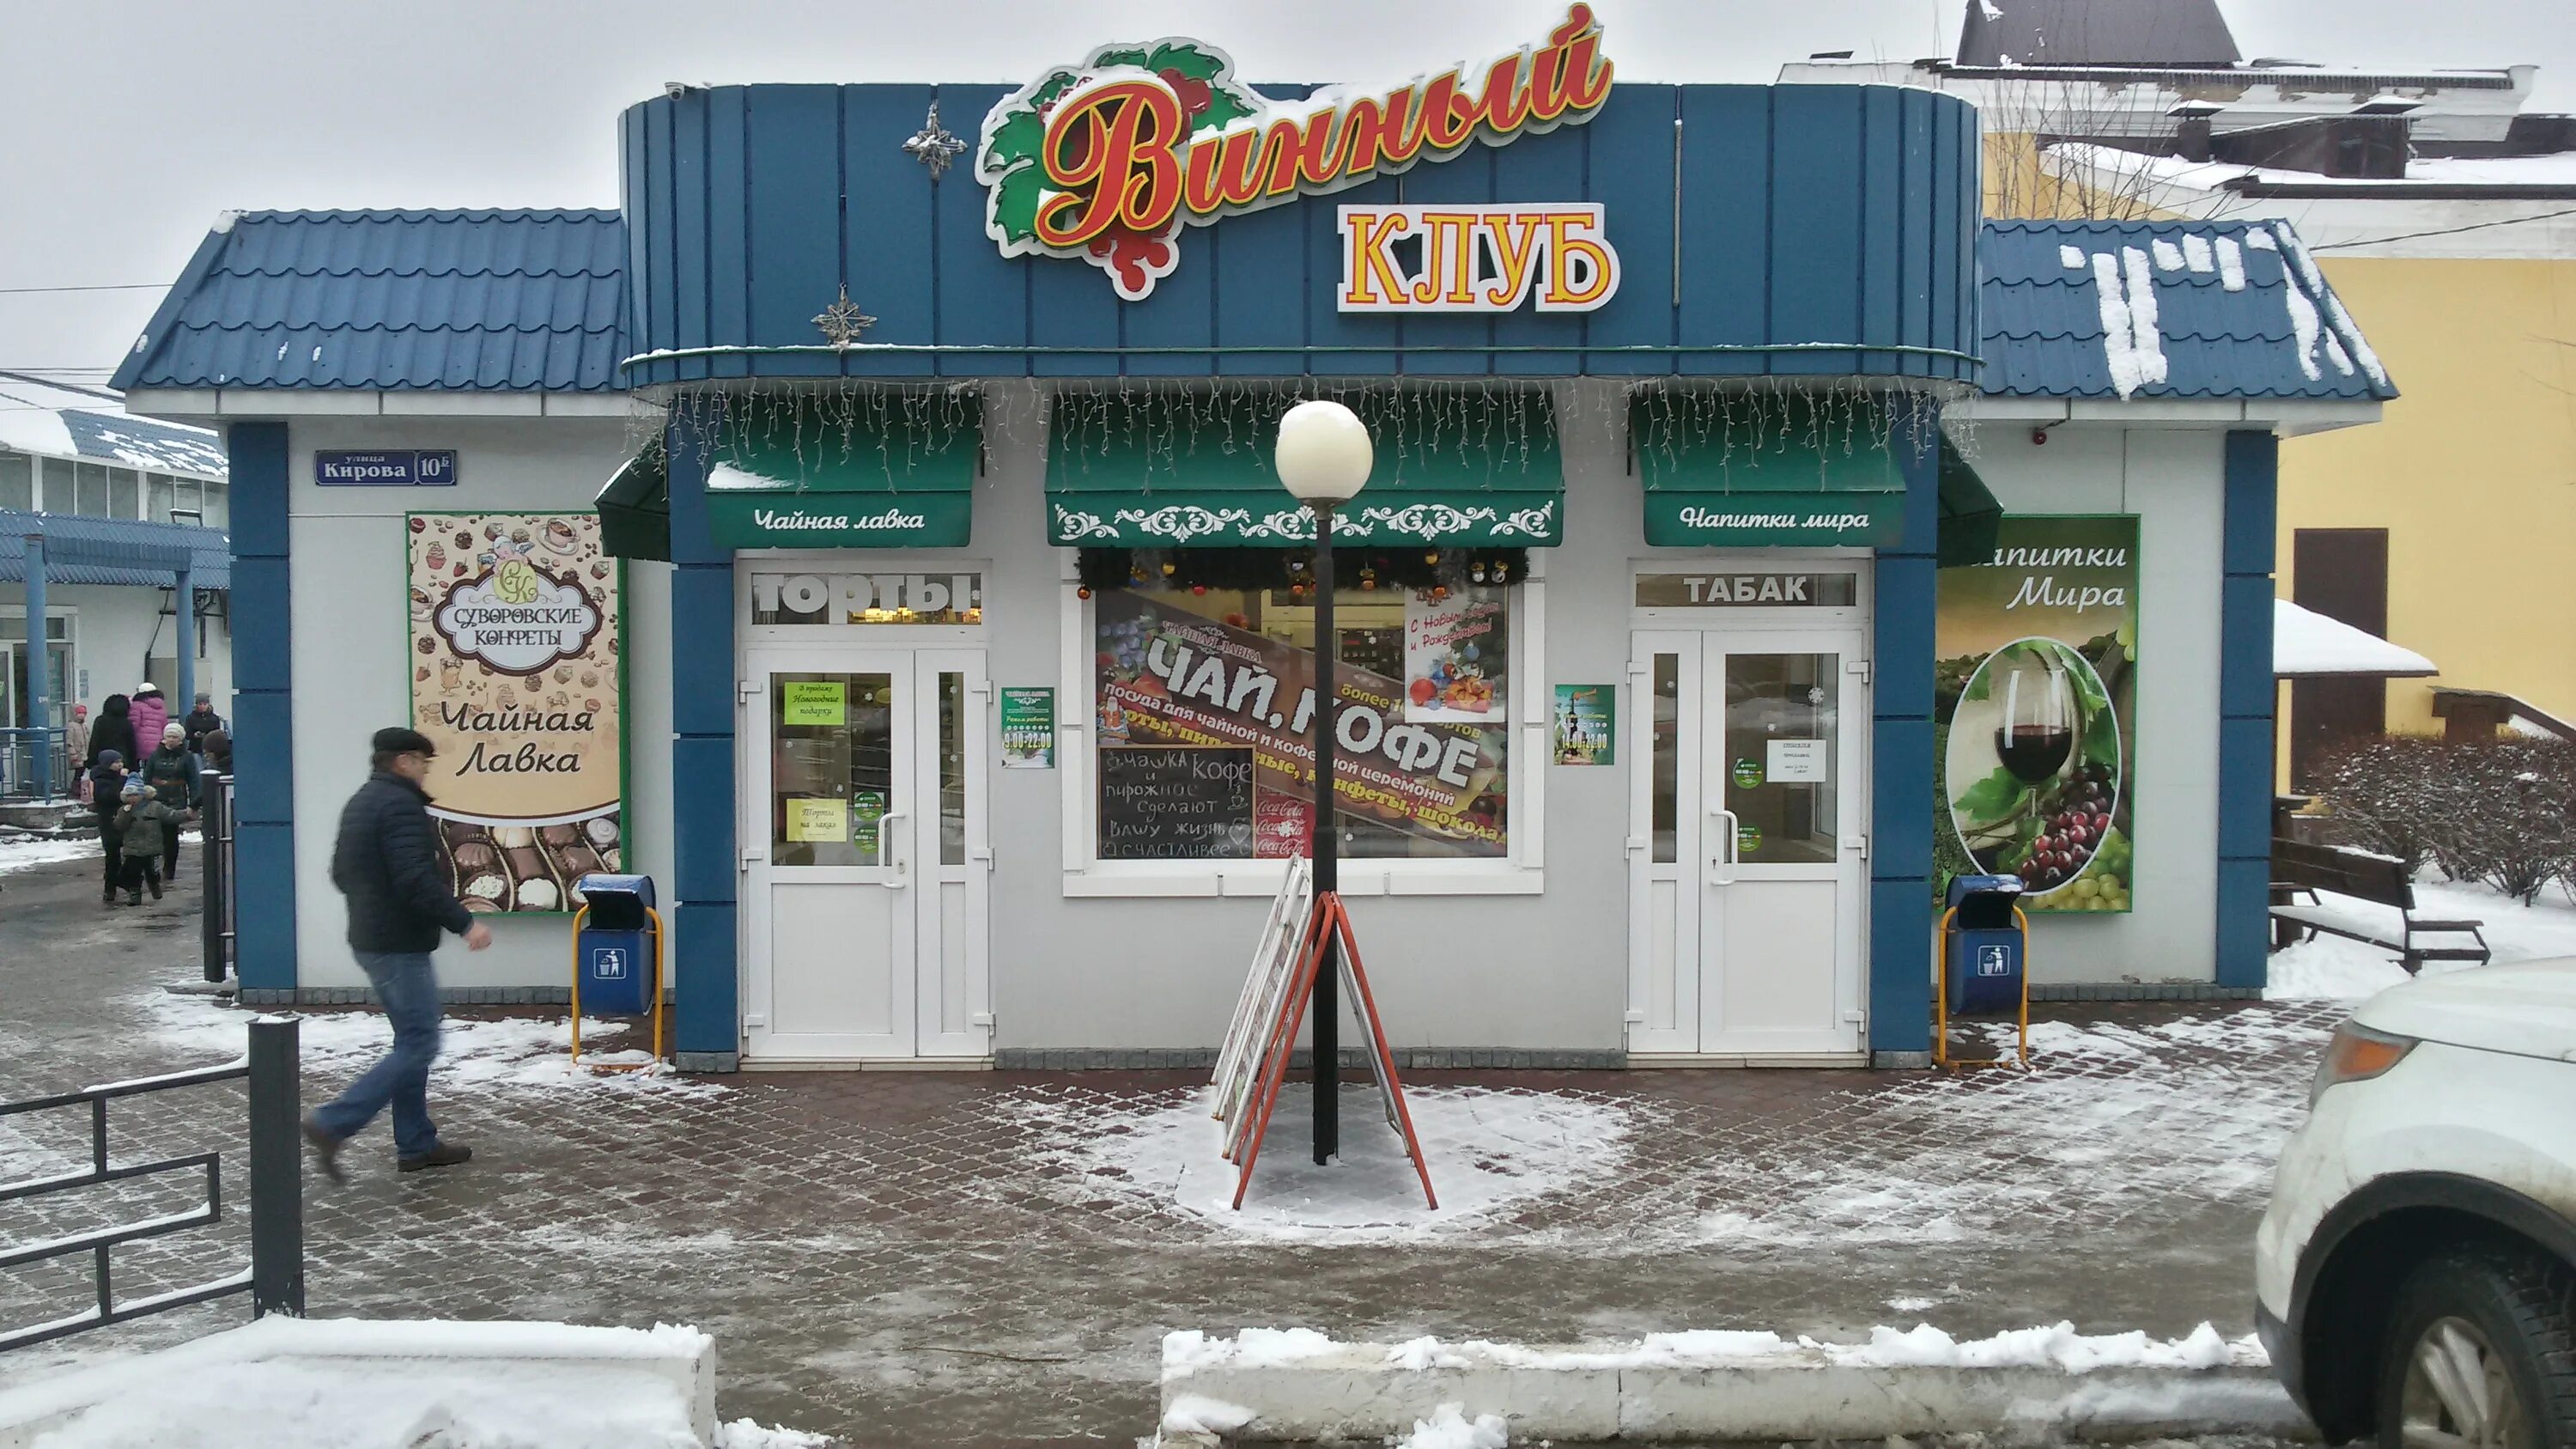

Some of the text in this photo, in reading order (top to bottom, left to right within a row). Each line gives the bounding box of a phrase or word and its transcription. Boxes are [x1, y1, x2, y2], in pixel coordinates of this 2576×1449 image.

[1035, 2, 1613, 248] Винный
[1346, 212, 1612, 305] КЛУБ
[324, 462, 407, 481] Кирова
[344, 455, 386, 465] улица
[754, 508, 925, 530] Чайная лавка
[1679, 507, 1869, 533] Напитки мира
[1971, 546, 2127, 568] апитки
[1683, 575, 1807, 603] ТАБАК
[2006, 575, 2125, 614] Мира
[453, 607, 582, 630] СУВОРОВСКИЕ
[474, 630, 562, 646] КОНФЕТЫ
[1217, 640, 1262, 664] ЛАВКА
[1147, 636, 1285, 730] ЧАЙ,
[1341, 683, 1390, 709] более
[440, 701, 594, 733] Чайная
[1104, 683, 1161, 710] посуда
[1162, 699, 1194, 721] для
[1196, 712, 1259, 742] чайной
[1260, 733, 1272, 746] и
[1361, 766, 1455, 807] церемоний
[456, 742, 581, 776] Лавка
